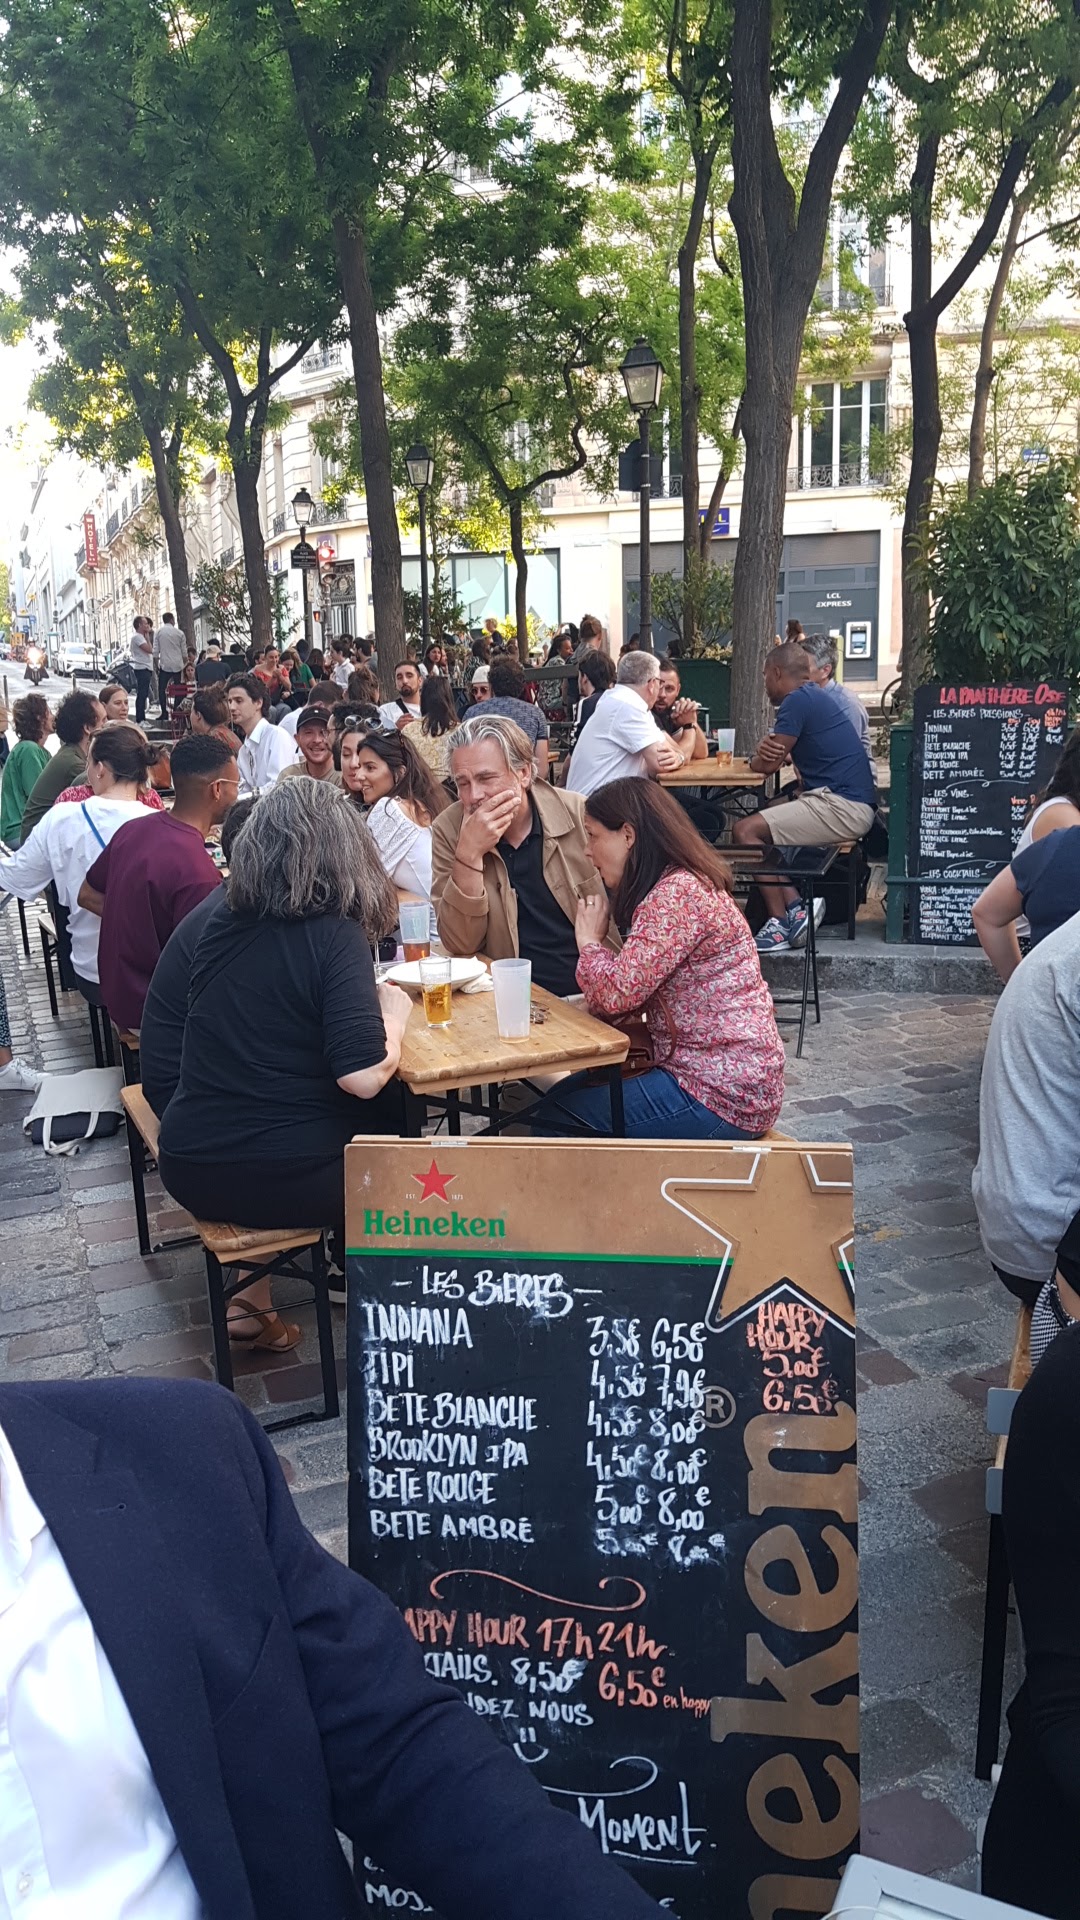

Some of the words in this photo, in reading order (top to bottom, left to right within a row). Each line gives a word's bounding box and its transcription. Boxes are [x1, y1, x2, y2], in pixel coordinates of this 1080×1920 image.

[87, 523, 95, 557] HOTEL
[815, 600, 852, 608] EXPRESS
[940, 687, 957, 704] LA
[933, 709, 946, 719] LES
[949, 767, 984, 778] AMBRÉE
[934, 789, 948, 797] LES
[363, 1208, 506, 1238] Heineken
[422, 1265, 464, 1298] LES
[758, 1301, 829, 1337] HAPPY
[587, 1315, 641, 1358] 3,50€
[651, 1318, 707, 1363] 6,50€
[746, 1323, 815, 1353] HOUR
[591, 1360, 647, 1399] 4,50€
[652, 1364, 711, 1411] 7,90€
[368, 1389, 430, 1427] BETE
[432, 1393, 538, 1432] BLANCHE
[587, 1400, 642, 1437] 4,50€
[649, 1408, 706, 1446] 8,00€
[368, 1426, 477, 1467] BROOKLYN
[587, 1441, 650, 1480] 4,50€
[650, 1448, 707, 1484] 8,00€
[368, 1465, 423, 1506] BETE
[427, 1470, 498, 1504] ROUGE
[595, 1484, 650, 1526] 5,00€
[658, 1486, 711, 1532] 8,00€
[370, 1509, 431, 1540] BETE
[404, 1608, 457, 1645] APPY
[467, 1612, 530, 1648] HOUR
[536, 1617, 594, 1660] 17h
[511, 1657, 584, 1693] 8,50€
[599, 1661, 666, 1708] 6,50€
[663, 1694, 679, 1709] en
[680, 1687, 711, 1718] happy
[529, 1700, 594, 1726] NOUS
